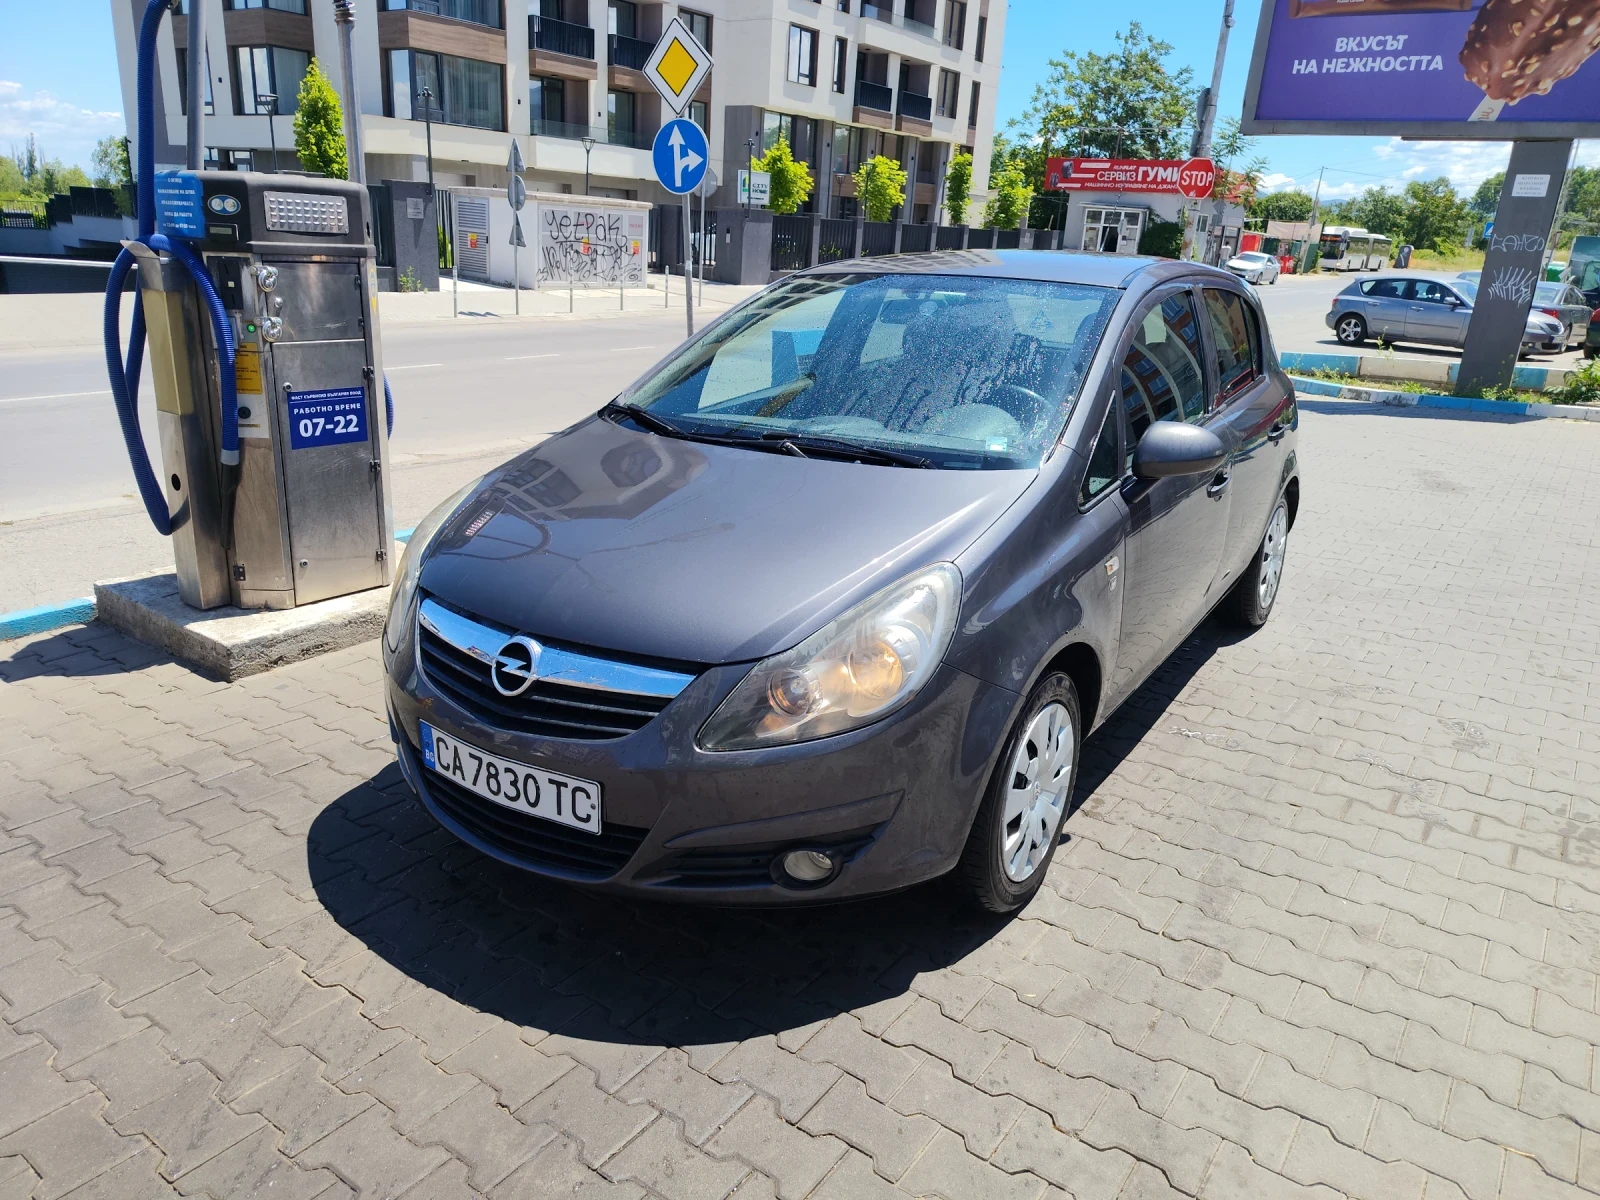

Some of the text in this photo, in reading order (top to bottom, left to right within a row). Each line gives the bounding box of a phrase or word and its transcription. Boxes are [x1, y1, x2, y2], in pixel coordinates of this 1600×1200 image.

[1335, 35, 1408, 52] ВКУСЪТ
[1292, 55, 1444, 74] НА НЕЖНОСТТА
[1097, 171, 1136, 181] СЕРВИЗ
[1181, 170, 1213, 186] STOP
[294, 403, 361, 414] РАБОТНО ВРЕМЕ
[299, 414, 359, 437] 07-22
[425, 750, 435, 763] BG
[548, 778, 592, 824] TC
